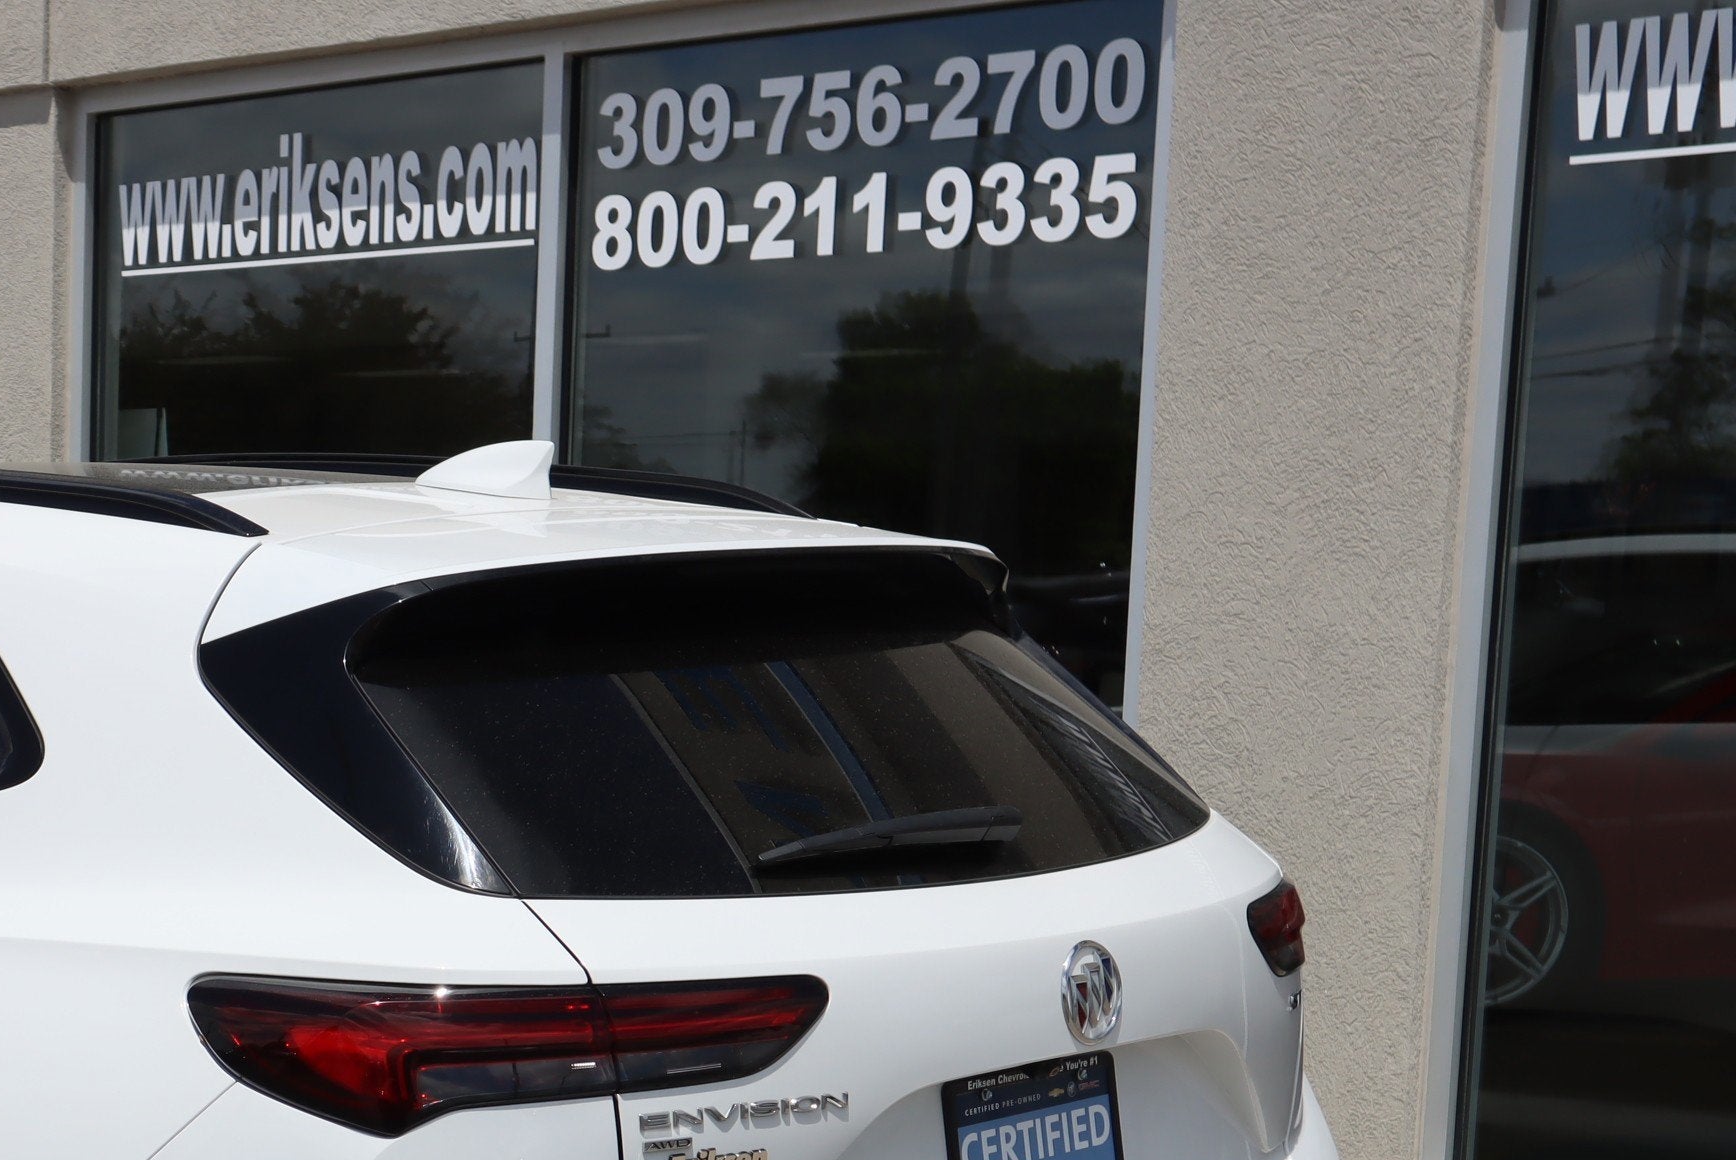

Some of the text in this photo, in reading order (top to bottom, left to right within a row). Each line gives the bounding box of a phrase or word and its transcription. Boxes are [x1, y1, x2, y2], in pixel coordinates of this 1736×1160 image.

[596, 37, 1146, 170] 309-756-2700
[1574, 7, 1736, 141] ww
[118, 131, 538, 267] www.eriksens.com
[591, 152, 1138, 272] 800-211-9335
[639, 1092, 849, 1133] ENVISION
[964, 1093, 1042, 1117] CERTIFIED PRE-OWNED
[967, 1077, 996, 1091] Eriksen
[645, 1138, 692, 1152] AWD
